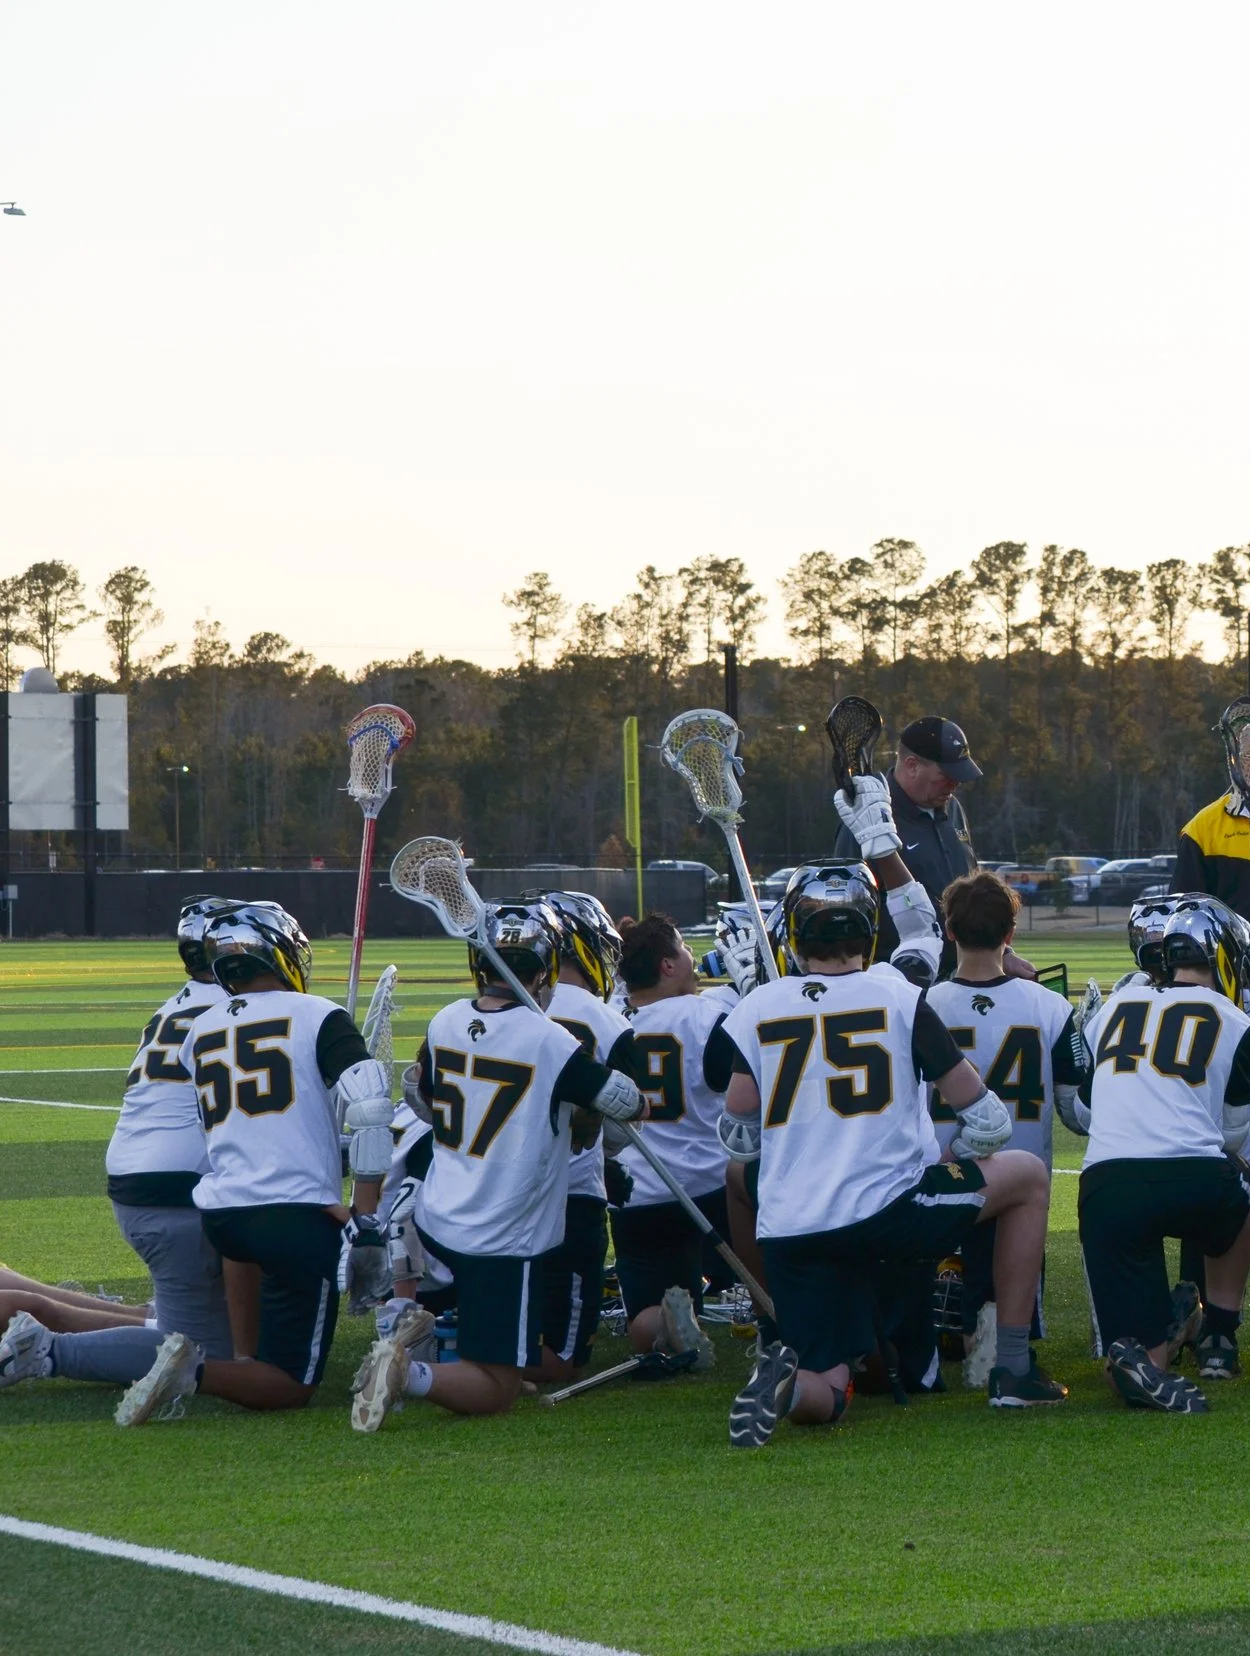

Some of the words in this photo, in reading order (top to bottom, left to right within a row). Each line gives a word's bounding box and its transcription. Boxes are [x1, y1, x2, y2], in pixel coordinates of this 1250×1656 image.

[501, 928, 521, 945] 28
[193, 1016, 296, 1133] 55
[756, 1007, 894, 1129] 75
[1096, 1000, 1223, 1088] 40
[432, 1046, 536, 1159] 57
